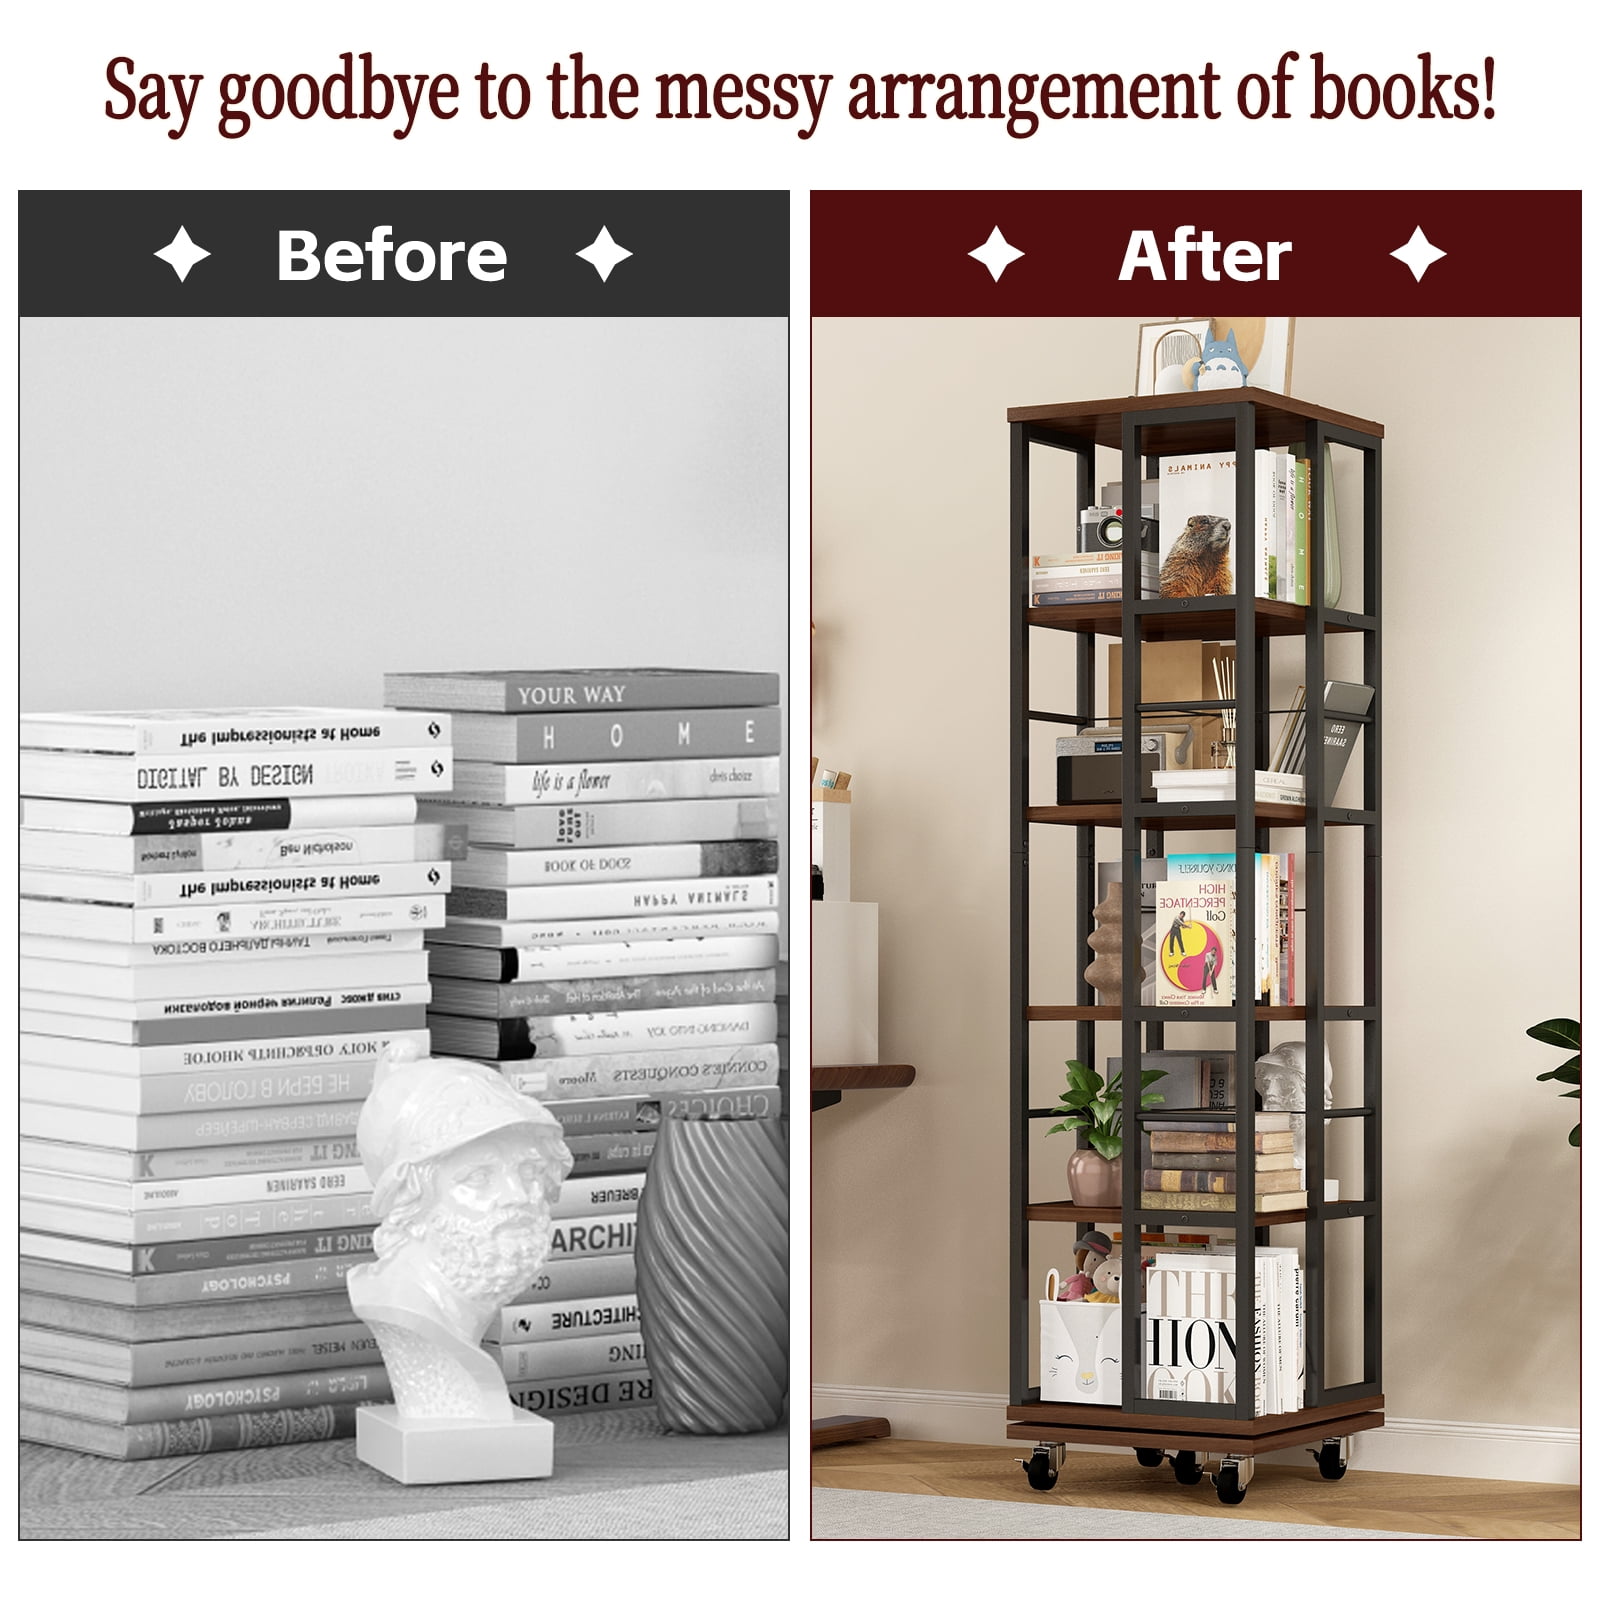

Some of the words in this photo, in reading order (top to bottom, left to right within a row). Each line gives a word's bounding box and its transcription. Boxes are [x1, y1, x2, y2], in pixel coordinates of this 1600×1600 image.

[519, 686, 577, 705] YOUR
[584, 685, 626, 703] WAY
[532, 770, 550, 798] life
[554, 772, 562, 790] is
[566, 776, 575, 790] a
[574, 768, 612, 798] flower
[556, 808, 566, 843] love
[566, 808, 574, 843] runs
[152, 942, 207, 956] ВОСТОКА
[209, 939, 269, 954] ДАЛЬНЕГО
[164, 1001, 231, 1015] водолазки
[234, 1000, 280, 1012] черной
[282, 996, 332, 1008] Религия
[184, 1050, 244, 1066] МНОГОЕ
[248, 1044, 334, 1060] ОБЪЯСНИТЬ
[338, 1042, 378, 1056] МОГУ
[184, 1080, 258, 1104] ГОЛОВУ
[262, 1078, 273, 1098] В
[275, 1074, 323, 1098] БЕРИ
[328, 1072, 350, 1094] НЕ
[310, 1144, 329, 1162] IT
[331, 1141, 361, 1160] NG
[266, 1176, 318, 1193] SAARINEN
[591, 1188, 638, 1204] BREUER
[315, 1236, 335, 1255] IT
[552, 1222, 637, 1252] ARCHI
[202, 1272, 291, 1293] PSYCHOLOGY
[312, 1340, 347, 1356] MEISEL
[350, 1336, 379, 1350] EVEN
[185, 1386, 280, 1412] PSYCHOLOGY
[509, 1382, 610, 1412] DESIGN
